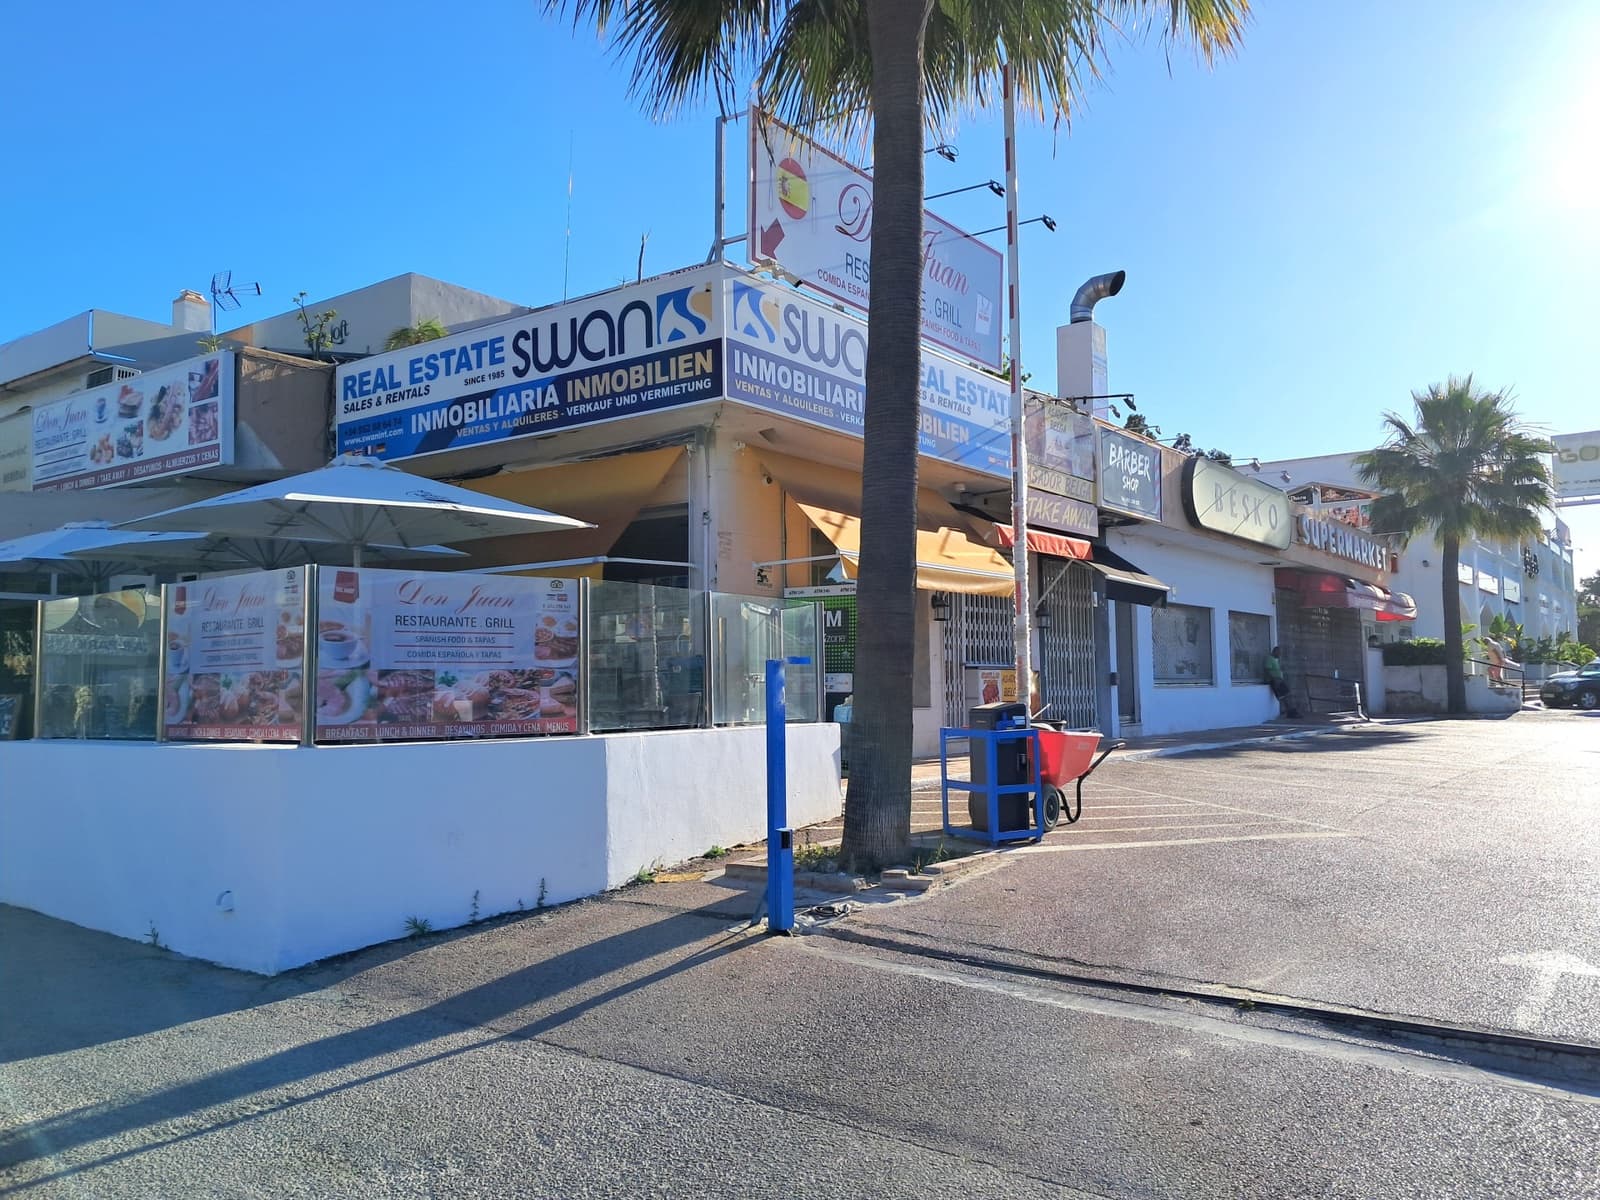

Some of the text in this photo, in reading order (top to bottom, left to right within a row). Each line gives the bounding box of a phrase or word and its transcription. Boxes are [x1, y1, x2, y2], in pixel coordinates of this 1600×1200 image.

[817, 269, 846, 290] COMIDA
[921, 320, 943, 333] PANISH
[934, 298, 962, 328] GRILL
[783, 303, 867, 378] swa
[343, 365, 401, 401] REAL
[409, 336, 505, 386] ESTATE
[464, 370, 505, 386] SINCE 1985
[734, 349, 864, 413] INMOBILIARI
[343, 385, 431, 414] SALES & RENTALS
[412, 349, 713, 434] INMOBILIARIA INMOBILIEN
[735, 379, 771, 399] VENTAS
[774, 391, 780, 401] Y
[782, 394, 834, 418] ALQUILERES
[920, 362, 1011, 417] EAL ESTAT
[930, 393, 935, 403] &
[938, 395, 972, 416] RENTALS
[457, 378, 712, 438] VENTAS Y ALQUILERES VERKAUF UND VERMIETUNG
[920, 413, 970, 445] BILIEN
[1109, 443, 1151, 481] BARBER
[1122, 475, 1139, 494] SHOP
[1028, 497, 1094, 529] TAKE AWAY
[1302, 514, 1387, 571] SUPERMARKET
[395, 578, 515, 615] Don Juan
[395, 615, 515, 629] RESTAURANTE GRILL
[407, 650, 436, 658] COMIDA
[415, 635, 447, 644] SPANISH
[448, 636, 466, 644] FOOD
[474, 636, 496, 644] TAPAS
[325, 728, 369, 738] BREAKFAST
[375, 727, 400, 737] LUNCH
[409, 726, 437, 736] DINNER
[445, 725, 485, 735] DESAYUNOS
[490, 724, 517, 733] COMIDA
[523, 723, 540, 732] CENA
[546, 721, 569, 732] MENUS
